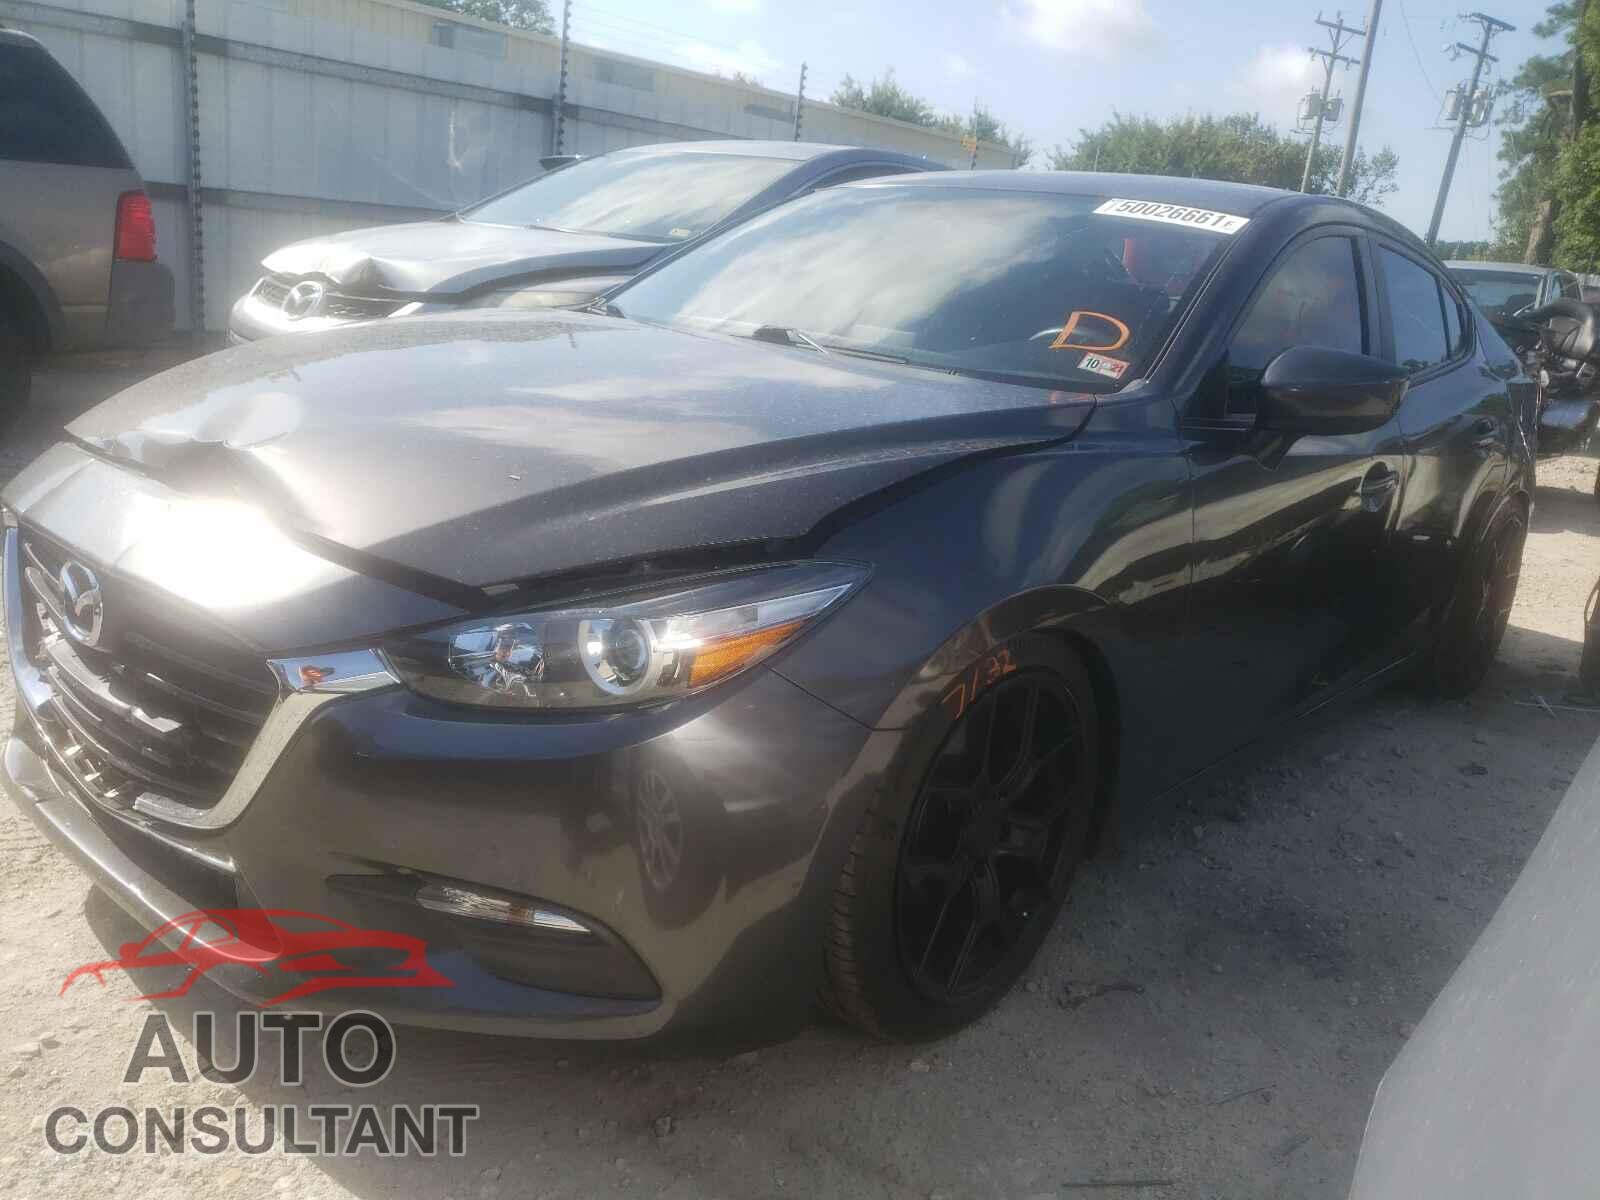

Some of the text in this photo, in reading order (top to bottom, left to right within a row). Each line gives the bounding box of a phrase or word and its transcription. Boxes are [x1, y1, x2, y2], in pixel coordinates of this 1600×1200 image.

[1117, 201, 1227, 227] 50026661
[1048, 311, 1130, 351] D
[1086, 358, 1100, 369] 10
